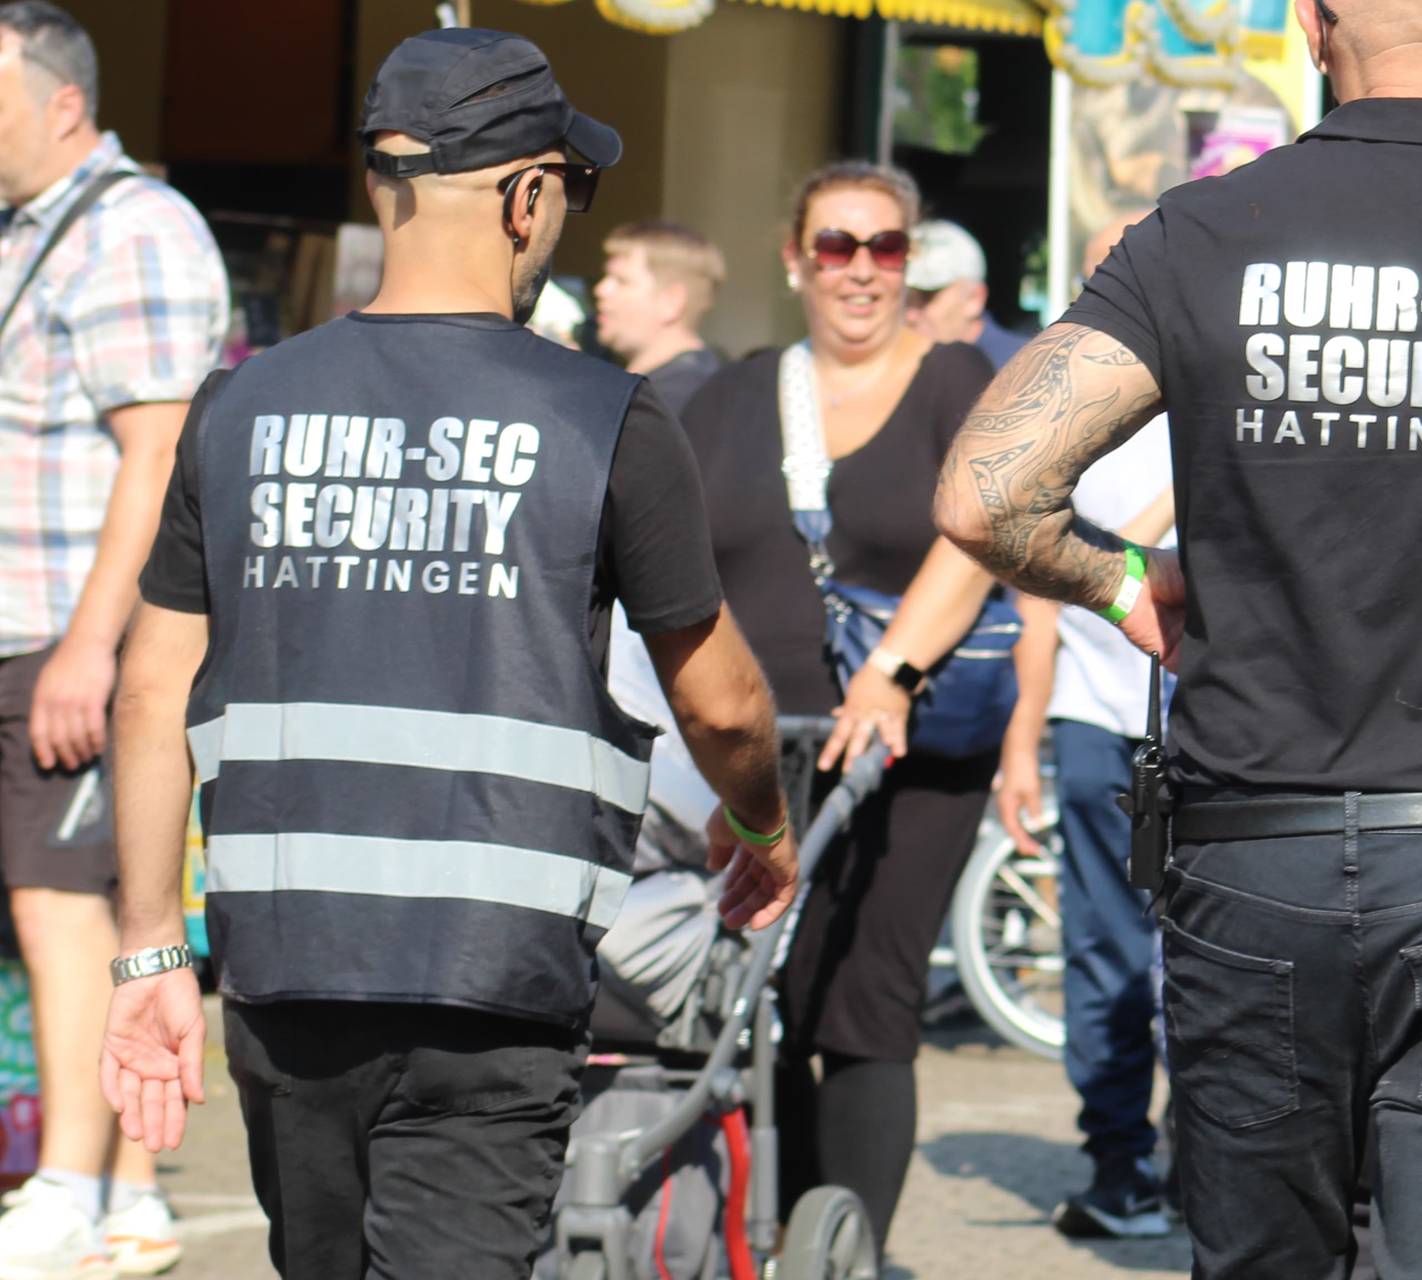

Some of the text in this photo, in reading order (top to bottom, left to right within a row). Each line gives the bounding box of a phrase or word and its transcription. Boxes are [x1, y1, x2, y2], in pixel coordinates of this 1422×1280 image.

[249, 414, 541, 487] RUHR-SEC
[250, 482, 522, 556] SECURITY
[242, 554, 520, 600] HATTINGEN
